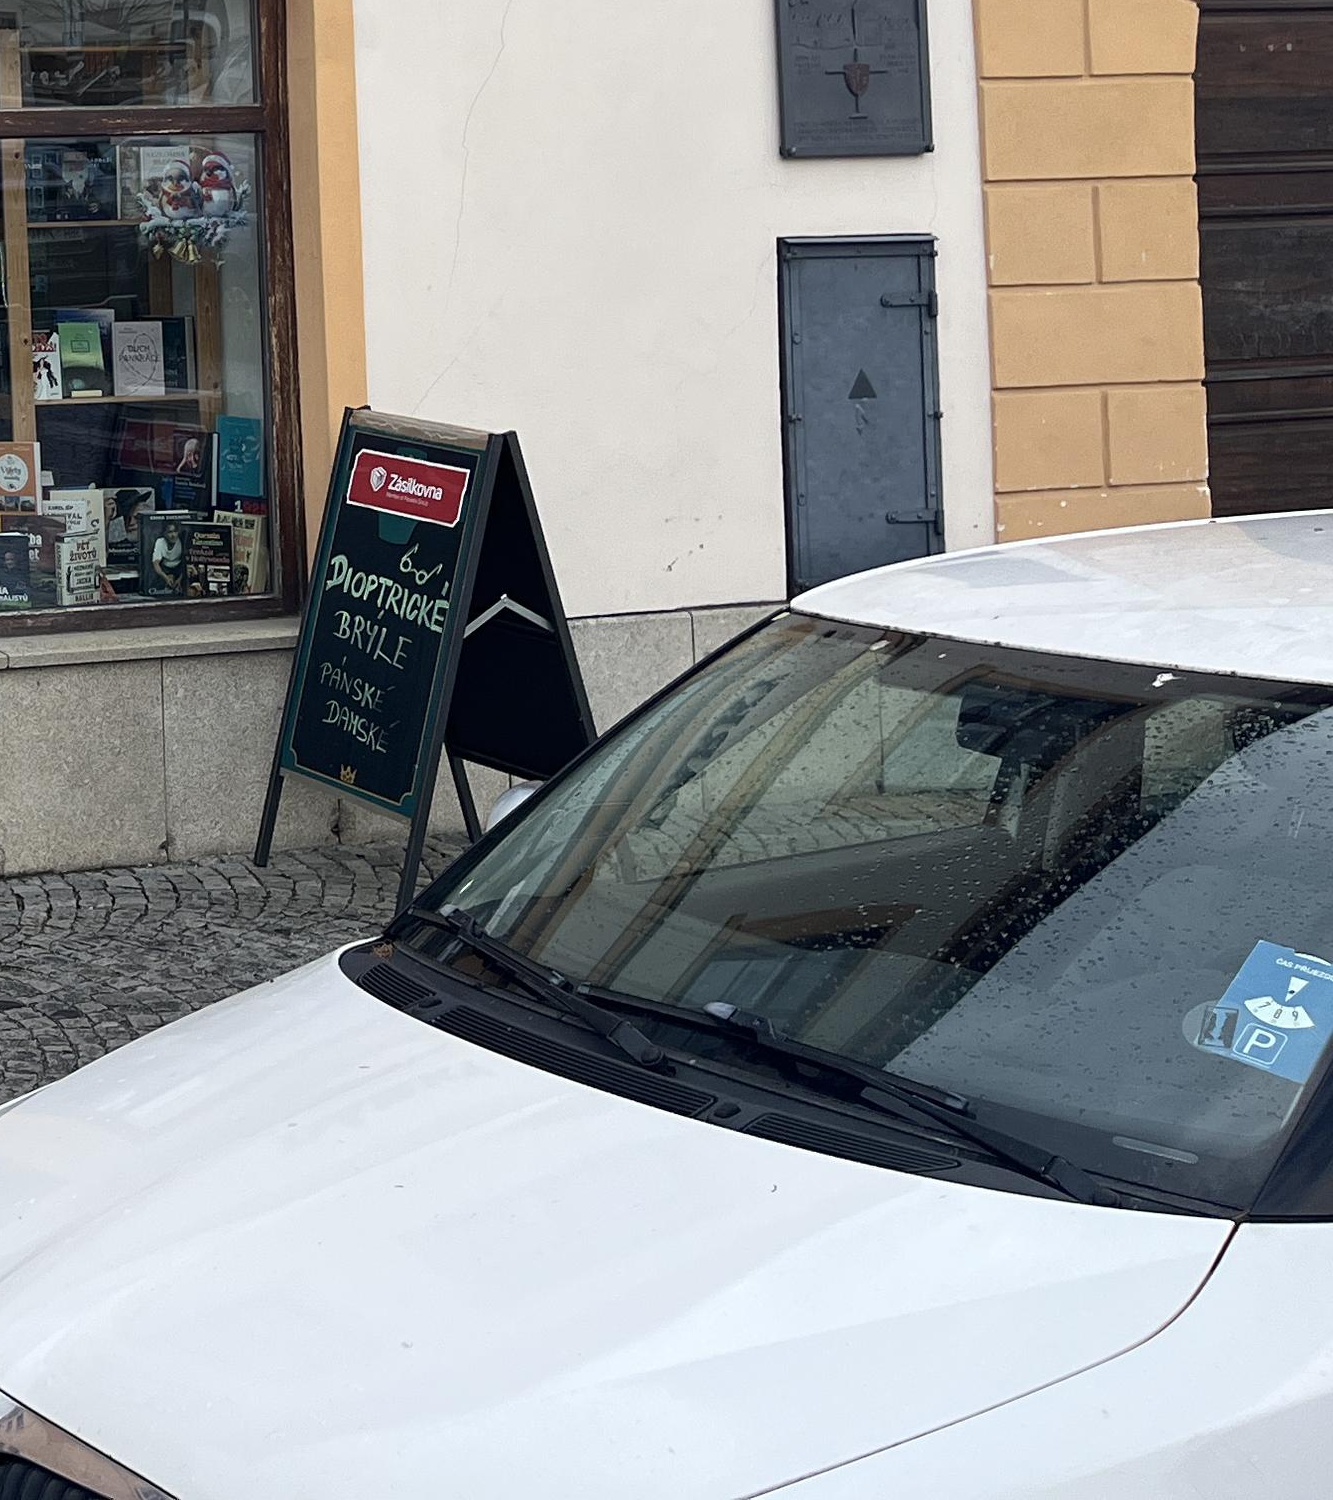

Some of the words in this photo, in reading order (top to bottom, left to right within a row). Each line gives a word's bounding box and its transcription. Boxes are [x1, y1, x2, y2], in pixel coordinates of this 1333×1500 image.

[387, 473, 443, 501] Zásilkovna
[326, 554, 450, 633] DIOPTRICKÉ
[333, 609, 413, 671] BRÝLE
[319, 655, 396, 714] PÁNSKÉ
[1276, 957, 1294, 969] ČAS
[1258, 1001, 1271, 1009] 7
[1273, 1008, 1283, 1019] 8
[1292, 1010, 1299, 1021] 9
[1242, 1028, 1277, 1054] P
